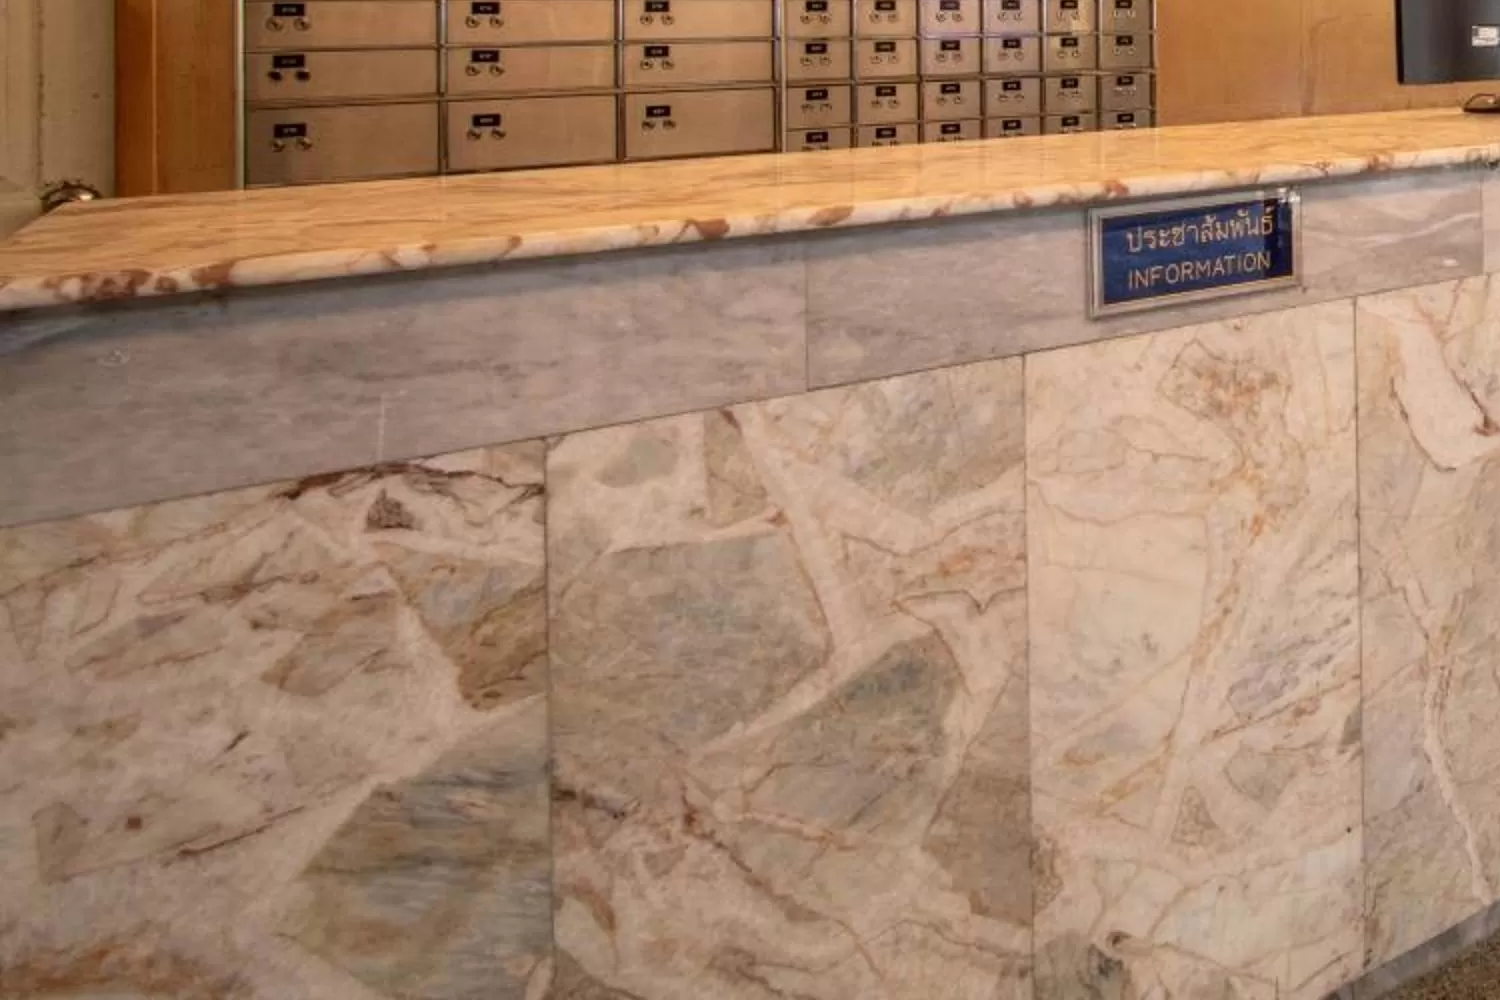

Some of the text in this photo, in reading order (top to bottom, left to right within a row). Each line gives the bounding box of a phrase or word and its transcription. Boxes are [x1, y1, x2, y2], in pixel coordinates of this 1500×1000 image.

[1126, 206, 1275, 253] ประชาสัมพันธ์
[1127, 251, 1272, 290] INFORMATION
